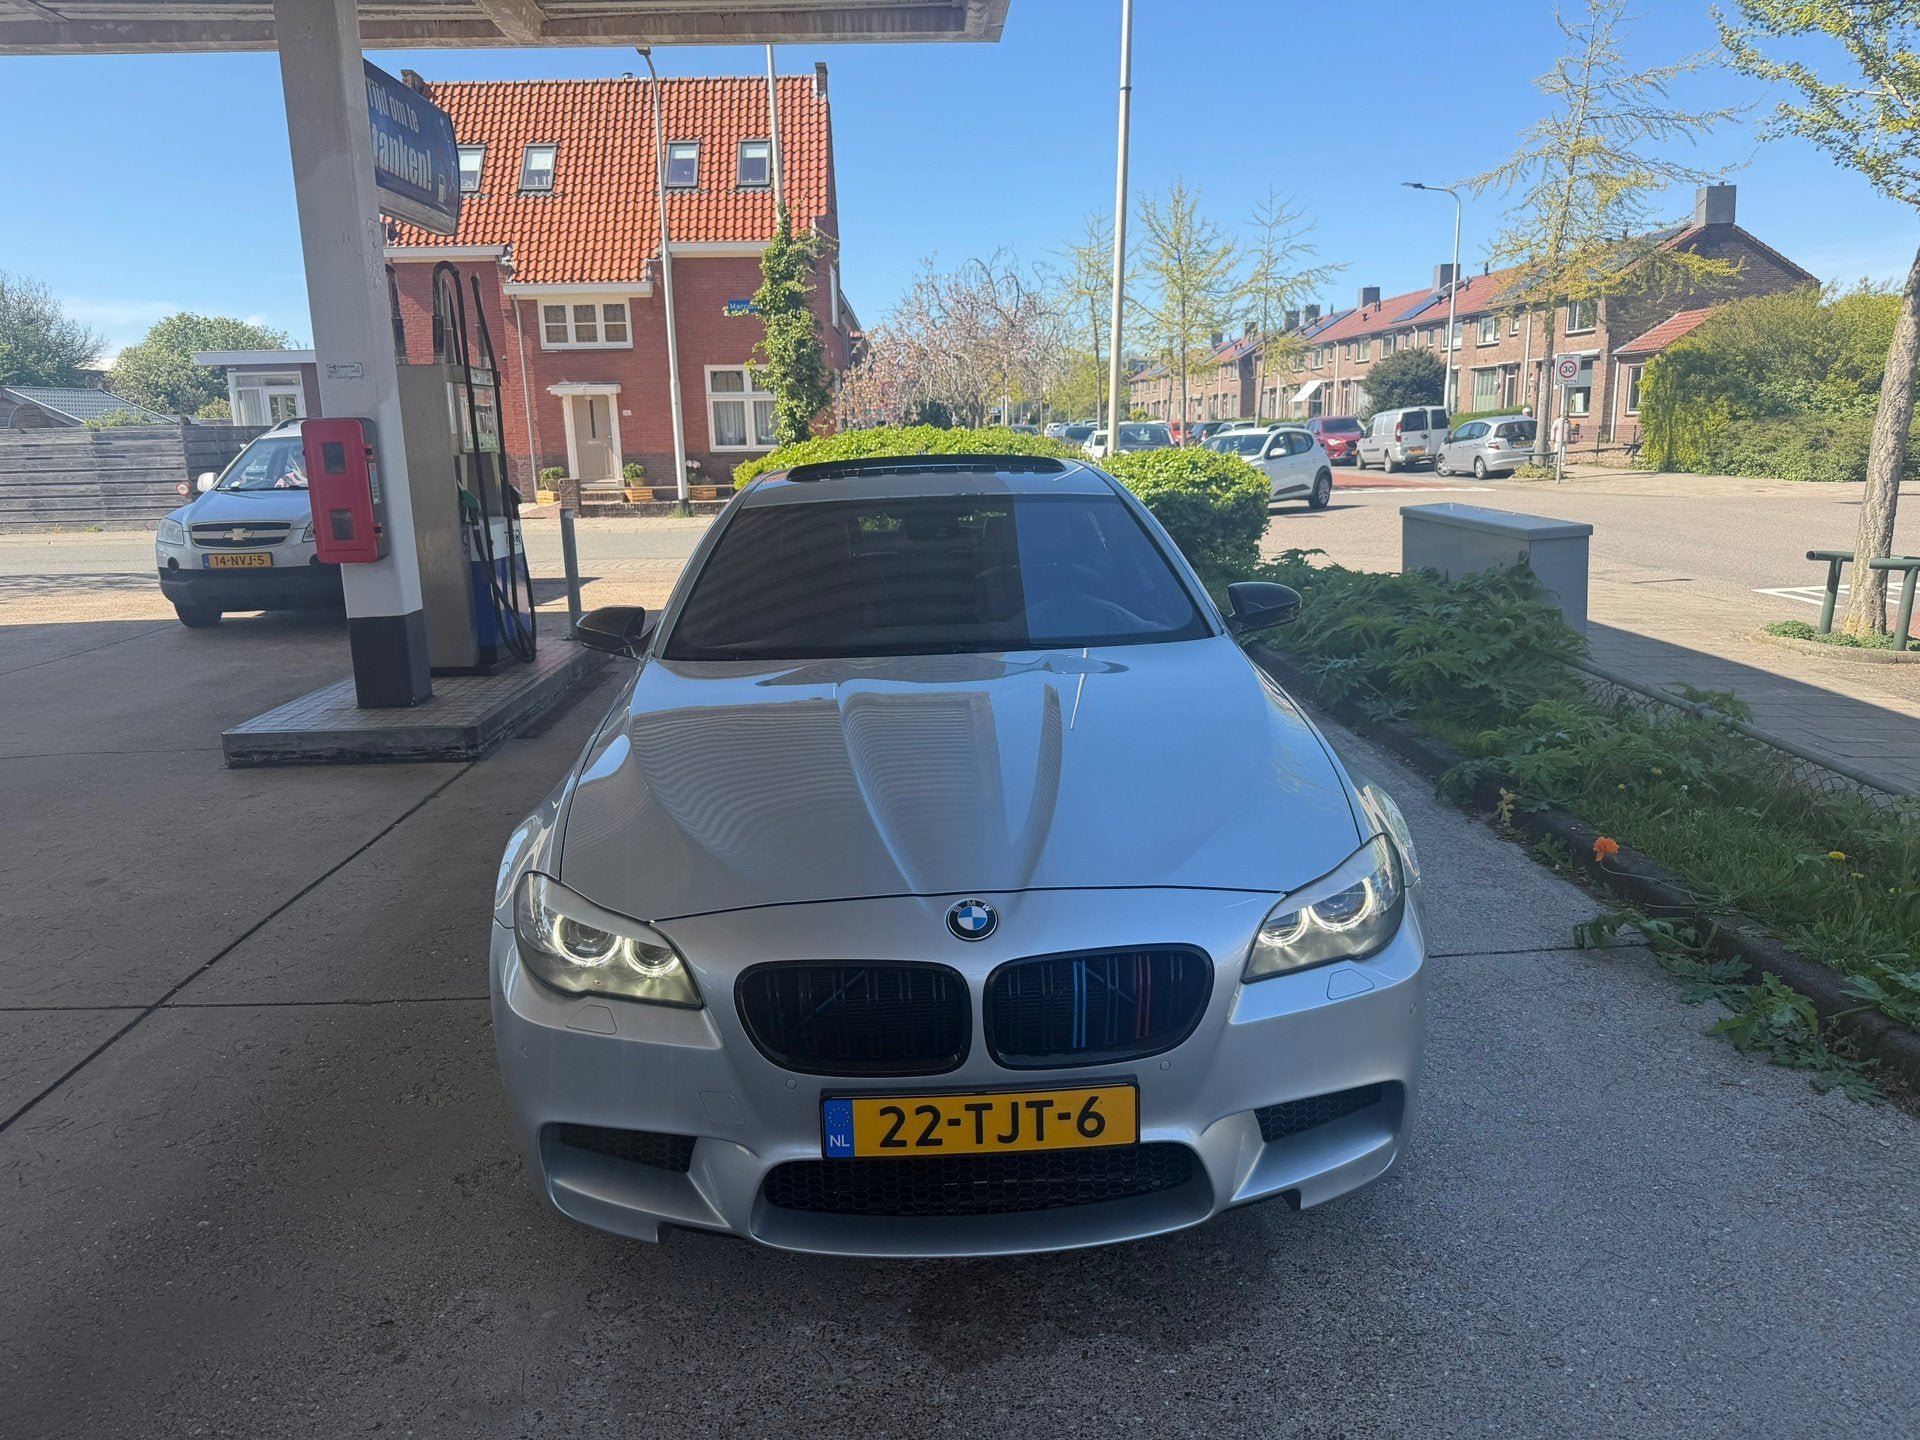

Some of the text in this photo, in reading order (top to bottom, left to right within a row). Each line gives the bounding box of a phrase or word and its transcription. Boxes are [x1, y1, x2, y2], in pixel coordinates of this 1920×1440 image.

[365, 76, 420, 134] Tijd om te
[372, 123, 433, 192] tanken!
[1562, 365, 1574, 374] 30
[214, 555, 265, 567] 14-NVJ-5
[952, 899, 992, 913] BMW
[879, 1095, 1107, 1148] 22-TJT-6
[829, 1134, 851, 1148] NL
